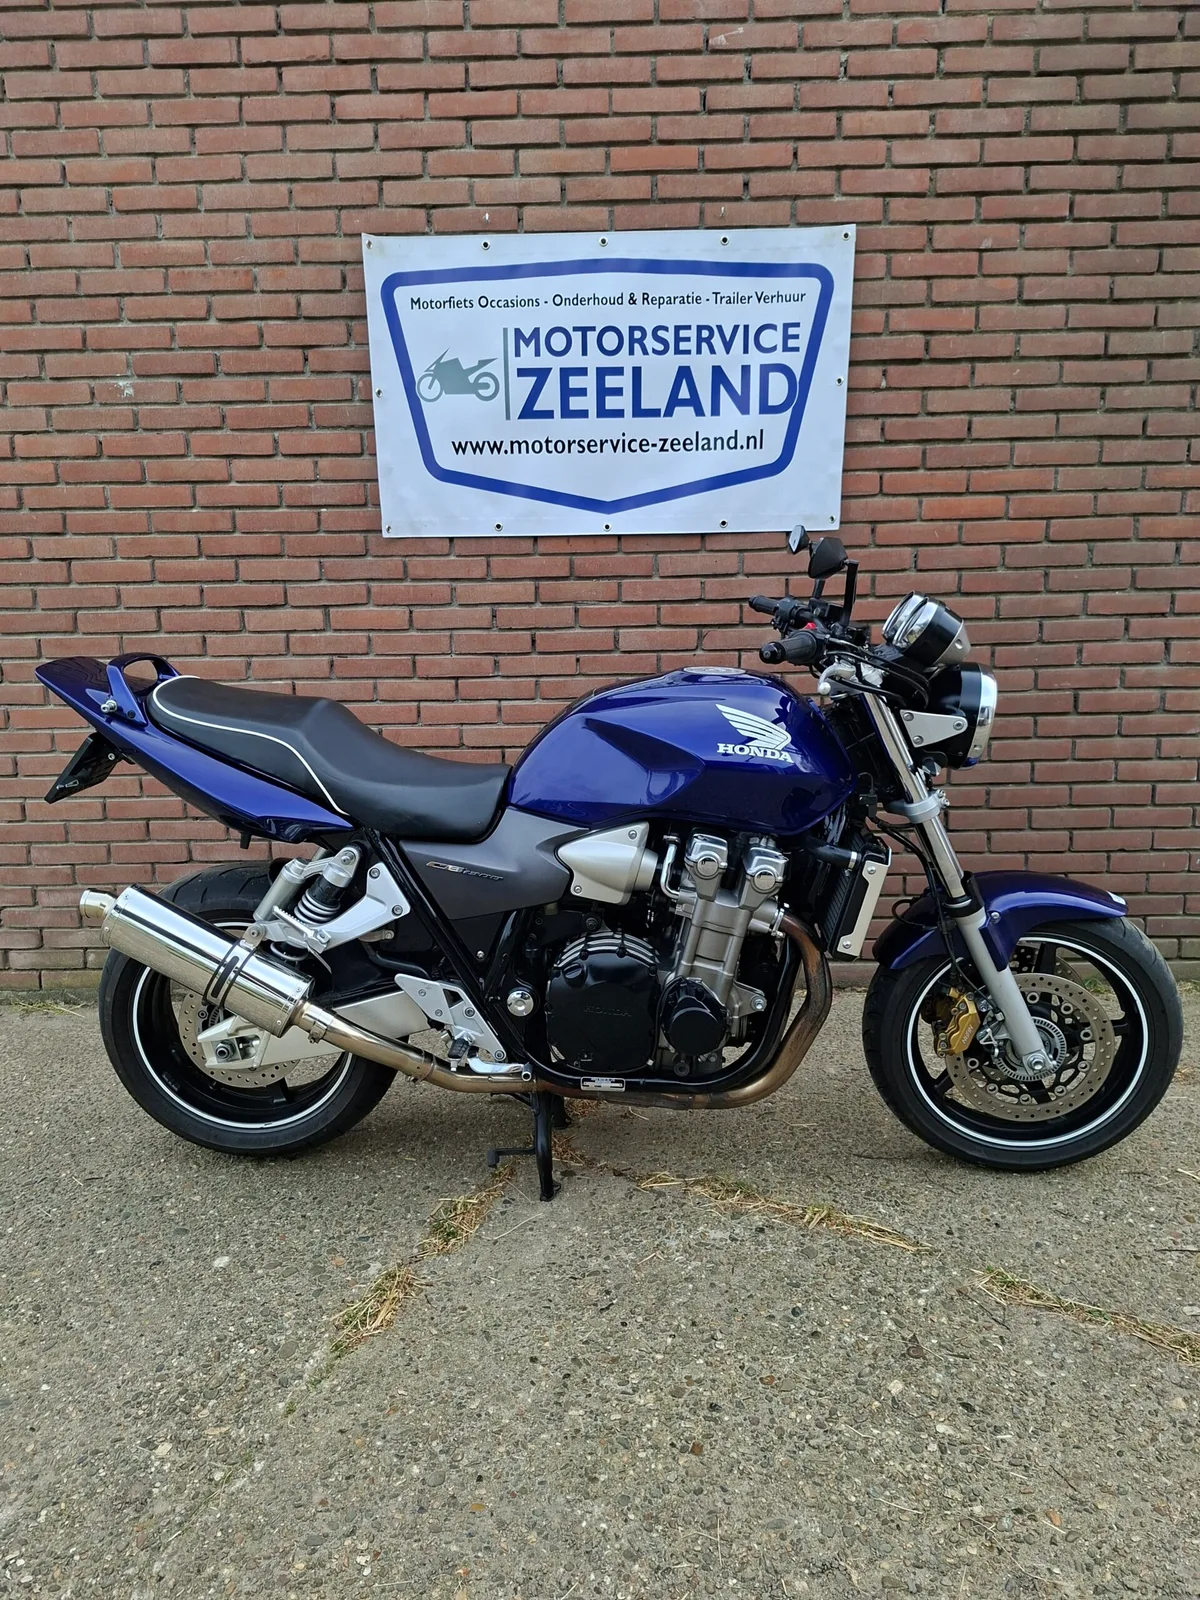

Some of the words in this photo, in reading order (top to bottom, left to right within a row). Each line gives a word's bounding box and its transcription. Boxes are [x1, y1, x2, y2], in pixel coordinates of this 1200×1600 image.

[410, 296, 474, 310] Motorfiets
[478, 295, 541, 309] Occasions
[552, 293, 624, 307] Onderhoud
[627, 292, 638, 306] &
[641, 291, 702, 309] Reparatie
[711, 291, 753, 305] Trailer
[754, 290, 807, 304] Verhuur
[514, 322, 801, 358] MOTORSERVICE
[516, 363, 798, 420] ZEELAND
[451, 428, 764, 456] www.motorservice-zeeland.nl
[716, 743, 795, 764] HONDA
